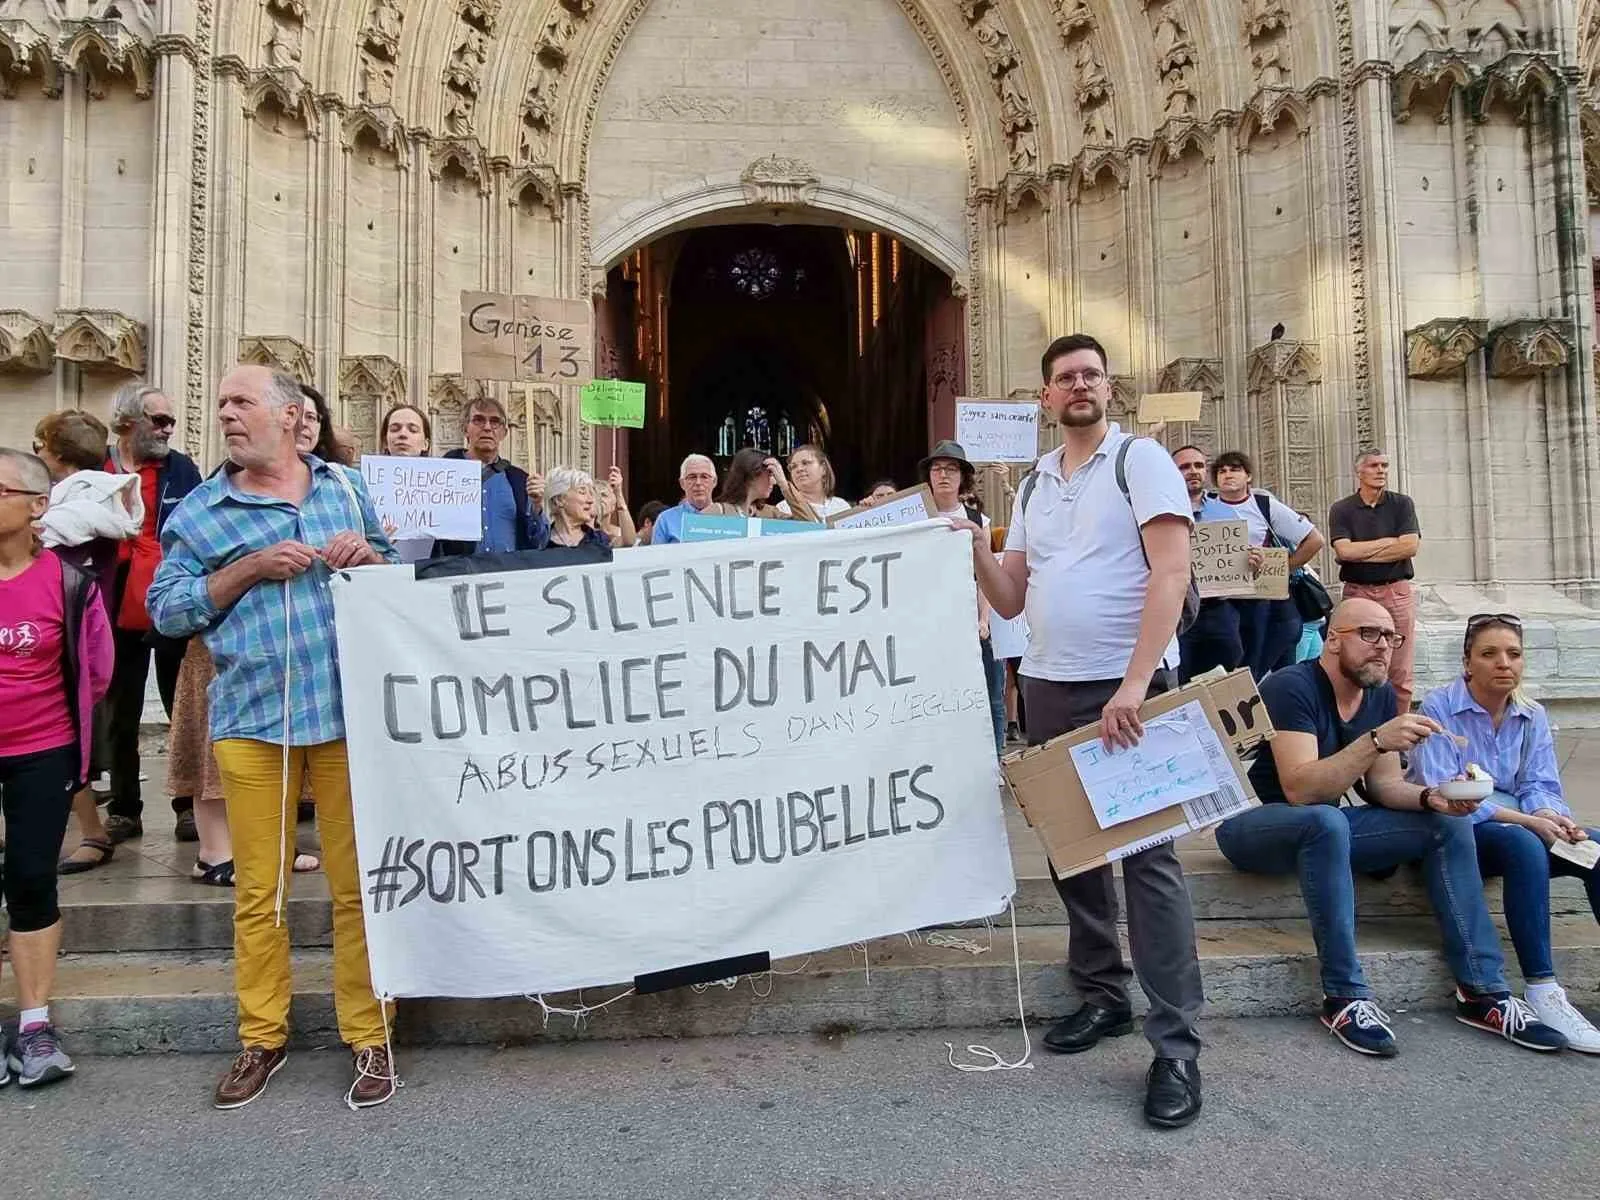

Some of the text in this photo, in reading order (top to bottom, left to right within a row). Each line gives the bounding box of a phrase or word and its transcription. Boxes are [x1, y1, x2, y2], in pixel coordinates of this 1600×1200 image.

[469, 302, 574, 340] Genèse
[521, 344, 580, 378] 1,3
[367, 462, 384, 486] LE
[393, 466, 456, 488] SILENCE
[369, 487, 479, 506] NE PARTICIPATION
[404, 509, 440, 529] MAL
[1190, 526, 1241, 545] AS DE
[1191, 557, 1233, 573] AS DE
[452, 551, 902, 641] LE SILENCE EST
[383, 635, 916, 744] COMPLICE DU MAL
[456, 748, 573, 804] ABUS
[585, 721, 763, 780] SEXUELS
[786, 703, 881, 743] DANS
